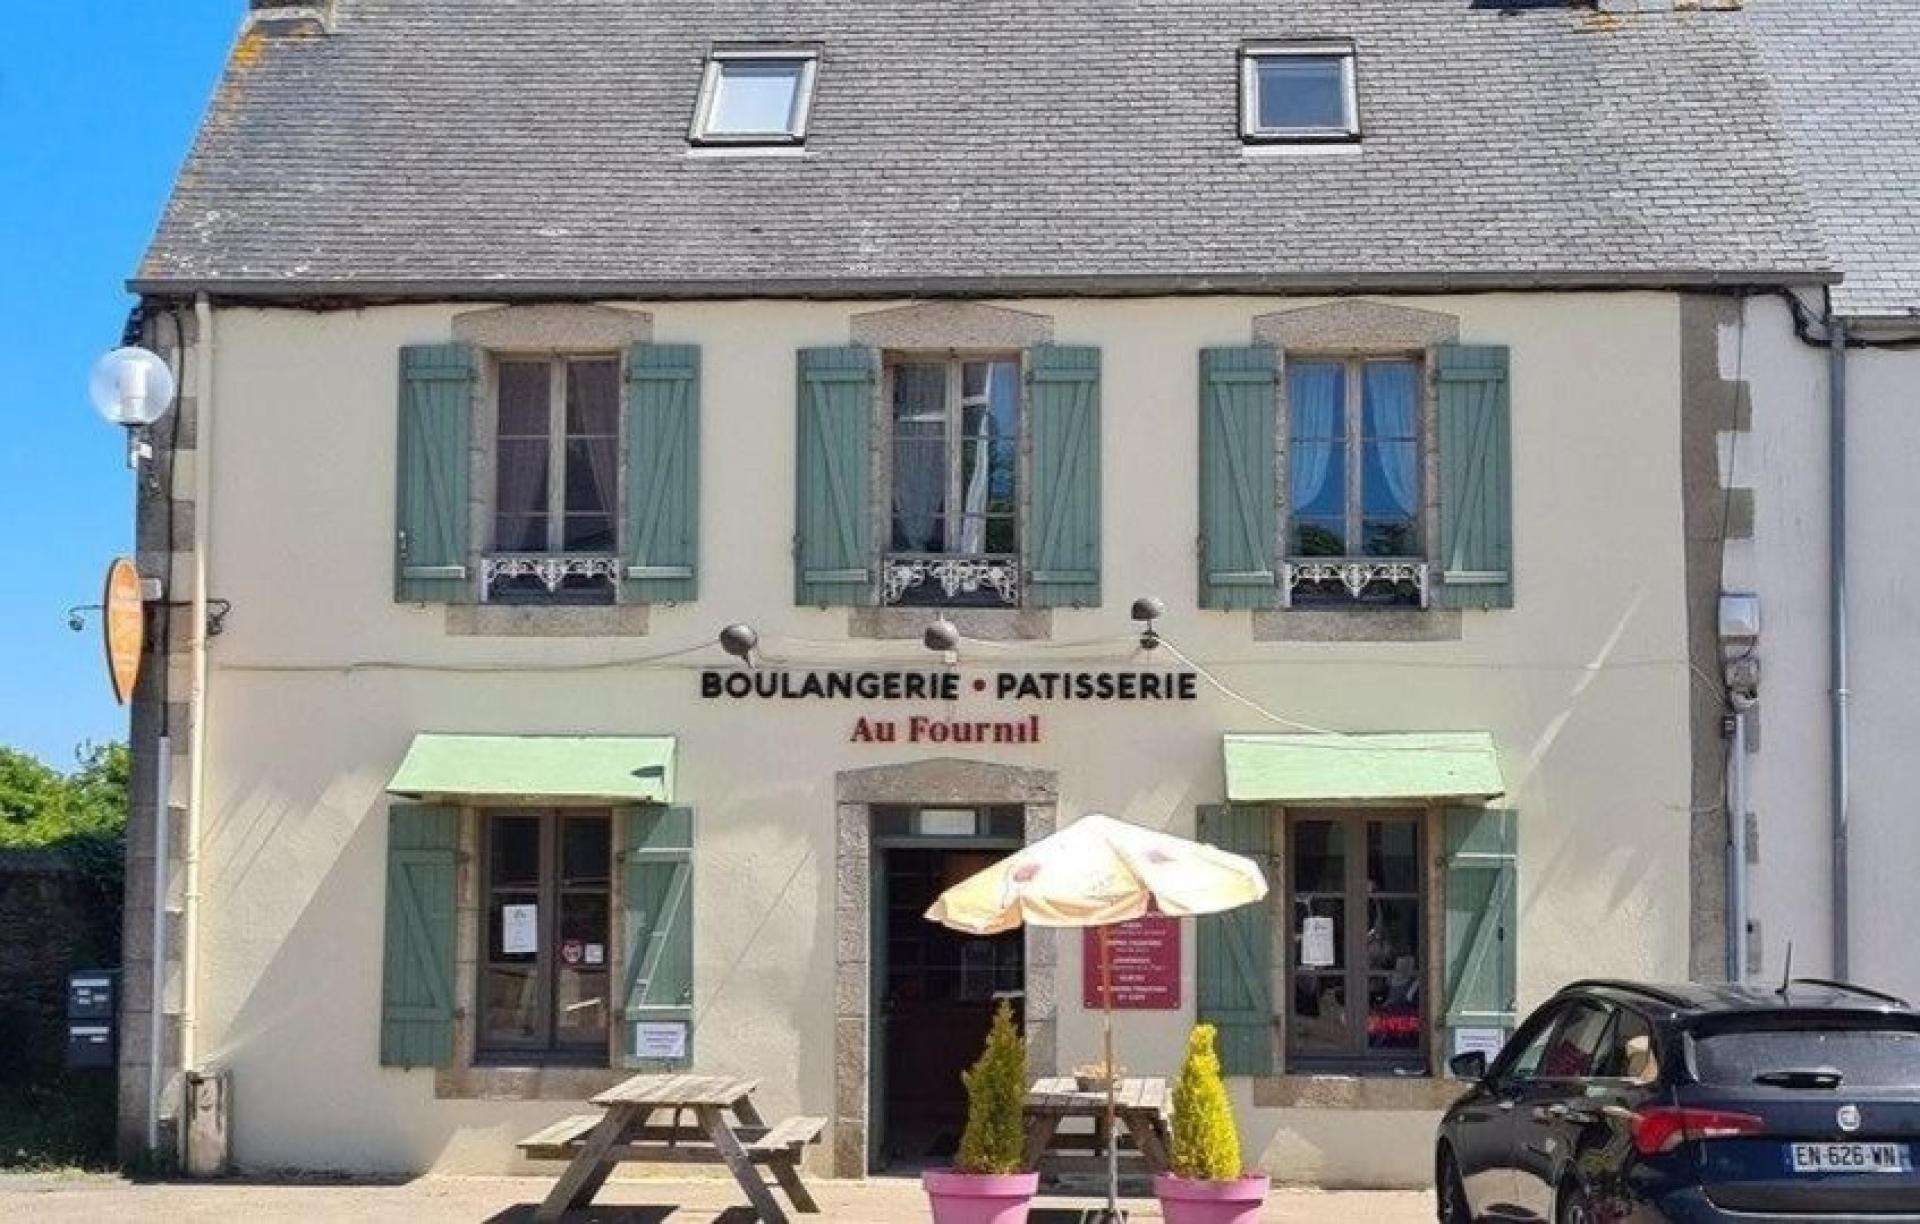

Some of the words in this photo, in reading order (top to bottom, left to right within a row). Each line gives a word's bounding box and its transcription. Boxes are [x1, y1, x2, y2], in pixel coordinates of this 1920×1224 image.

[700, 671, 960, 700] BOULANGERIE
[996, 672, 1198, 699] PATISSERIE
[850, 715, 896, 743] Au
[908, 715, 1041, 743] Fournil
